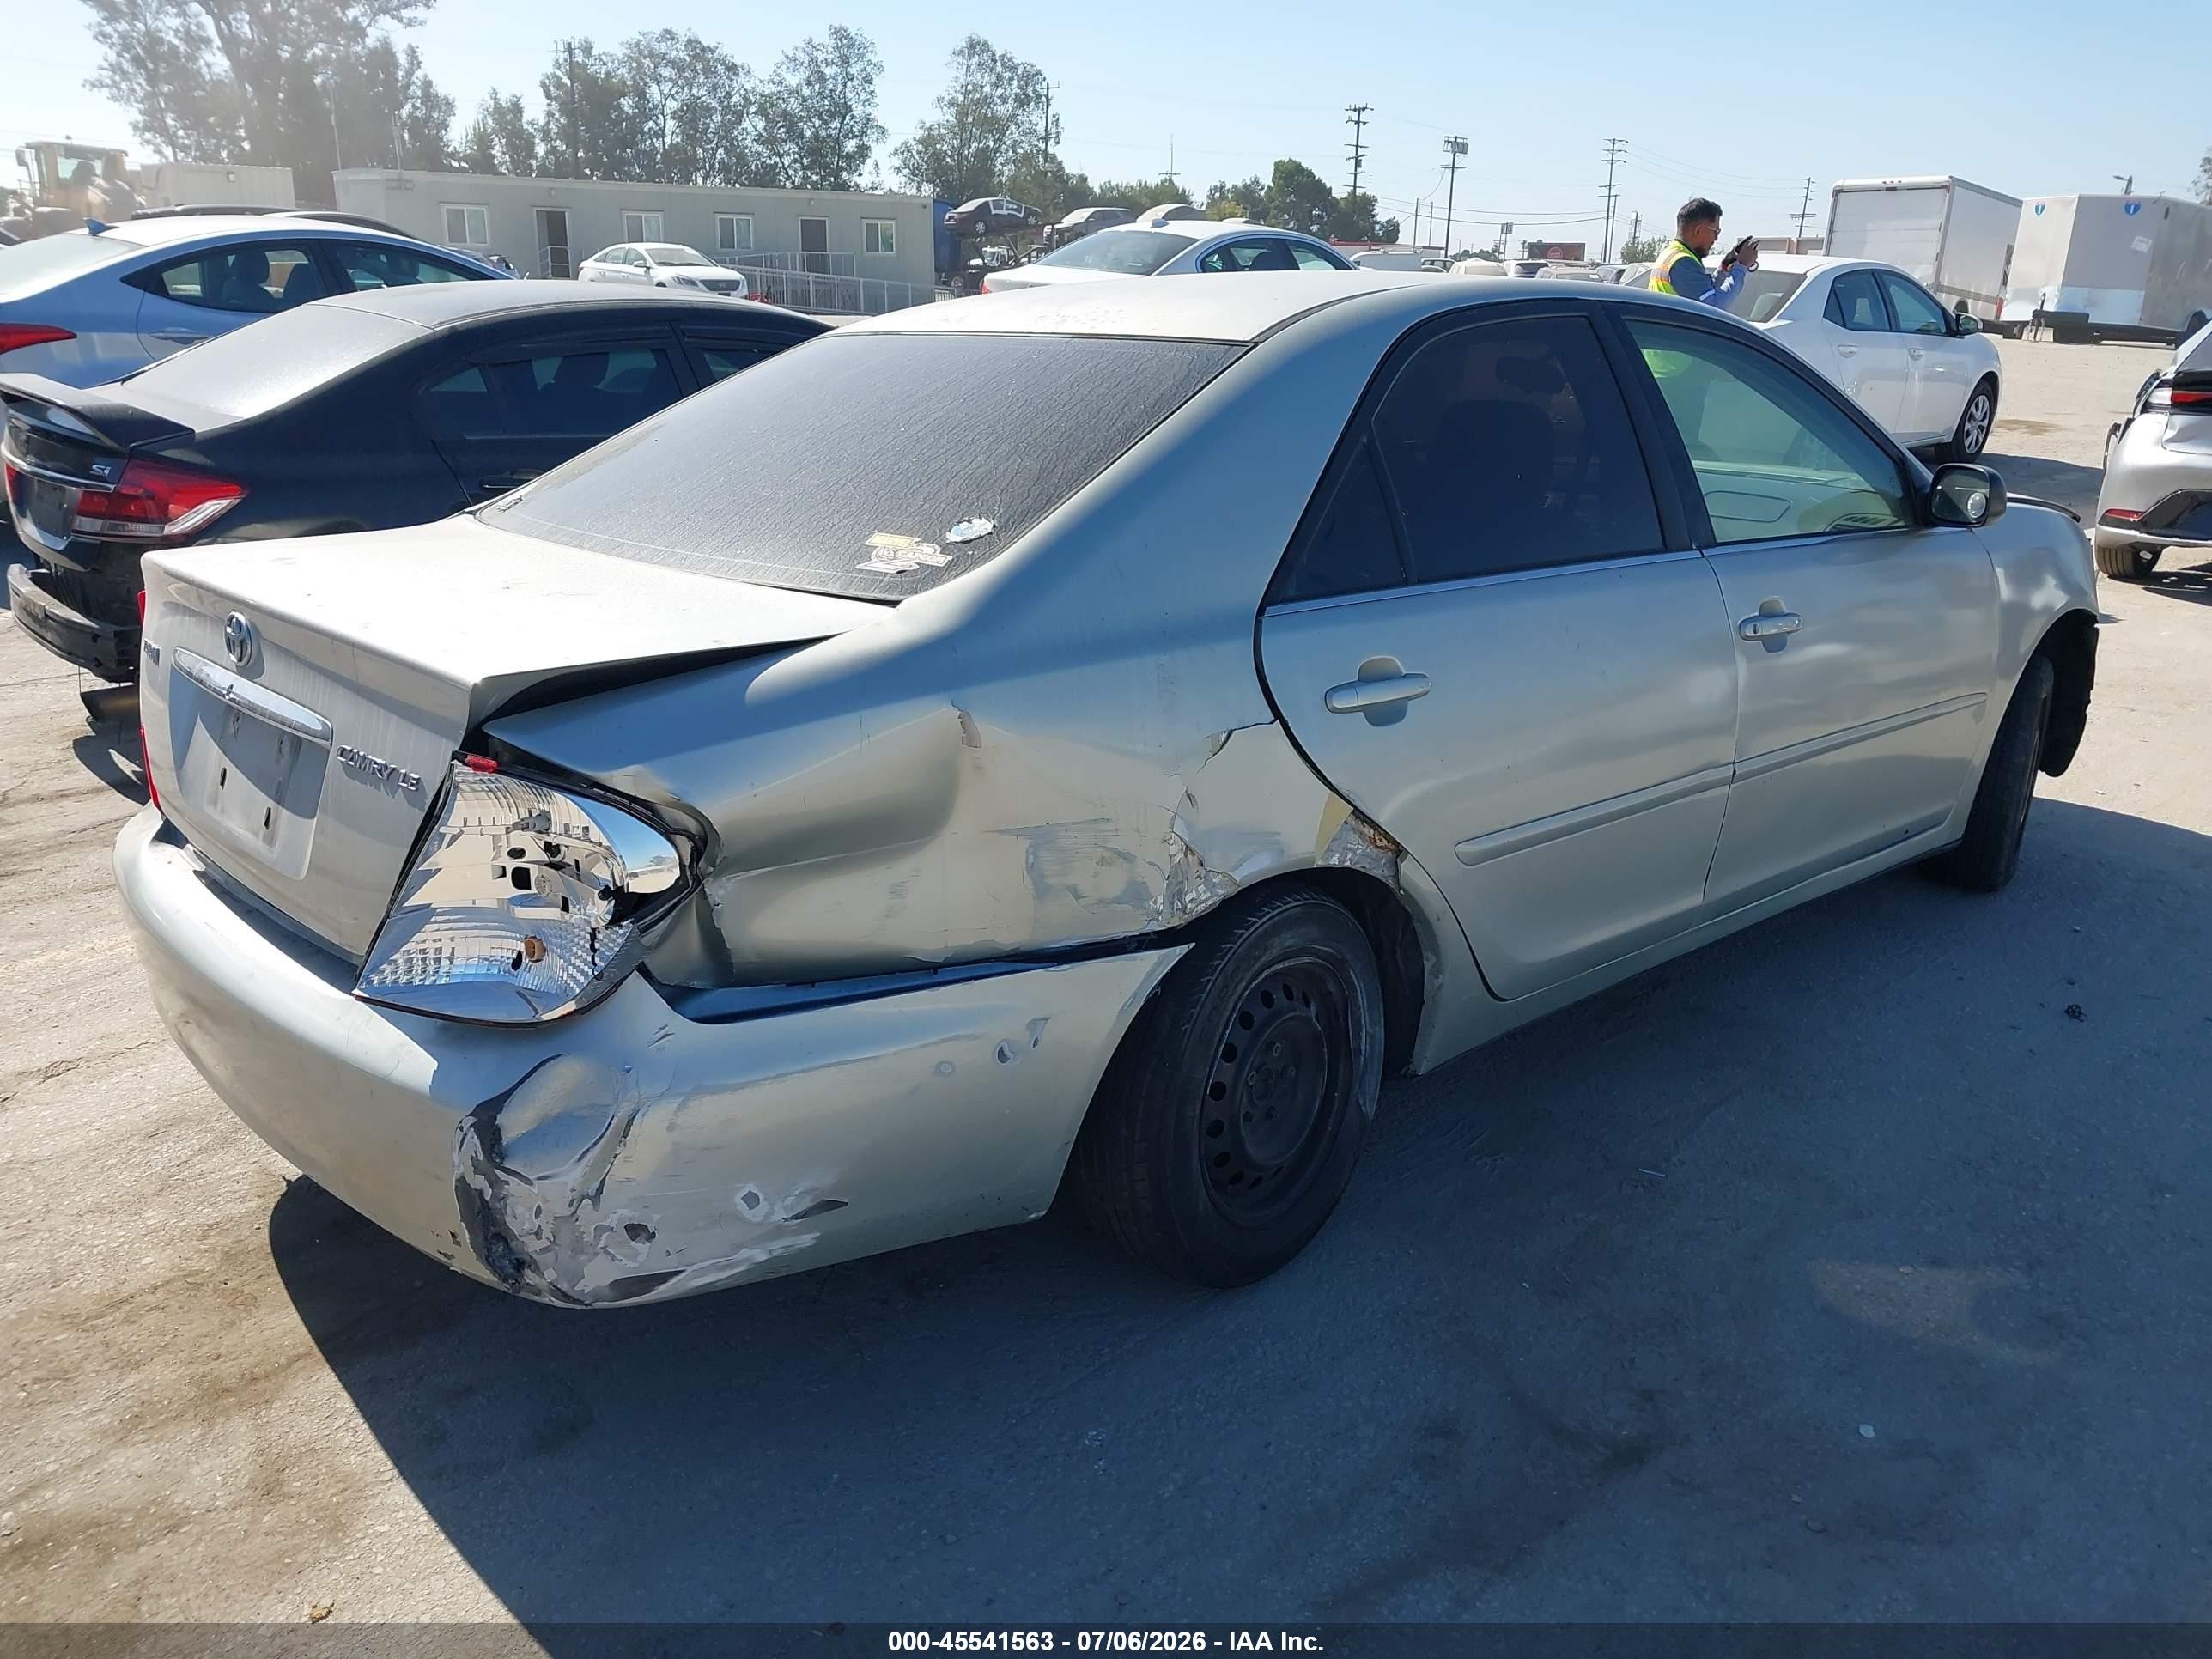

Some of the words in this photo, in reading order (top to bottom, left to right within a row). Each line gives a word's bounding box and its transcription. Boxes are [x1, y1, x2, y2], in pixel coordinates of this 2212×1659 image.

[89, 465, 111, 478] Si
[336, 744, 396, 780] CAMRY
[398, 769, 421, 793] LE
